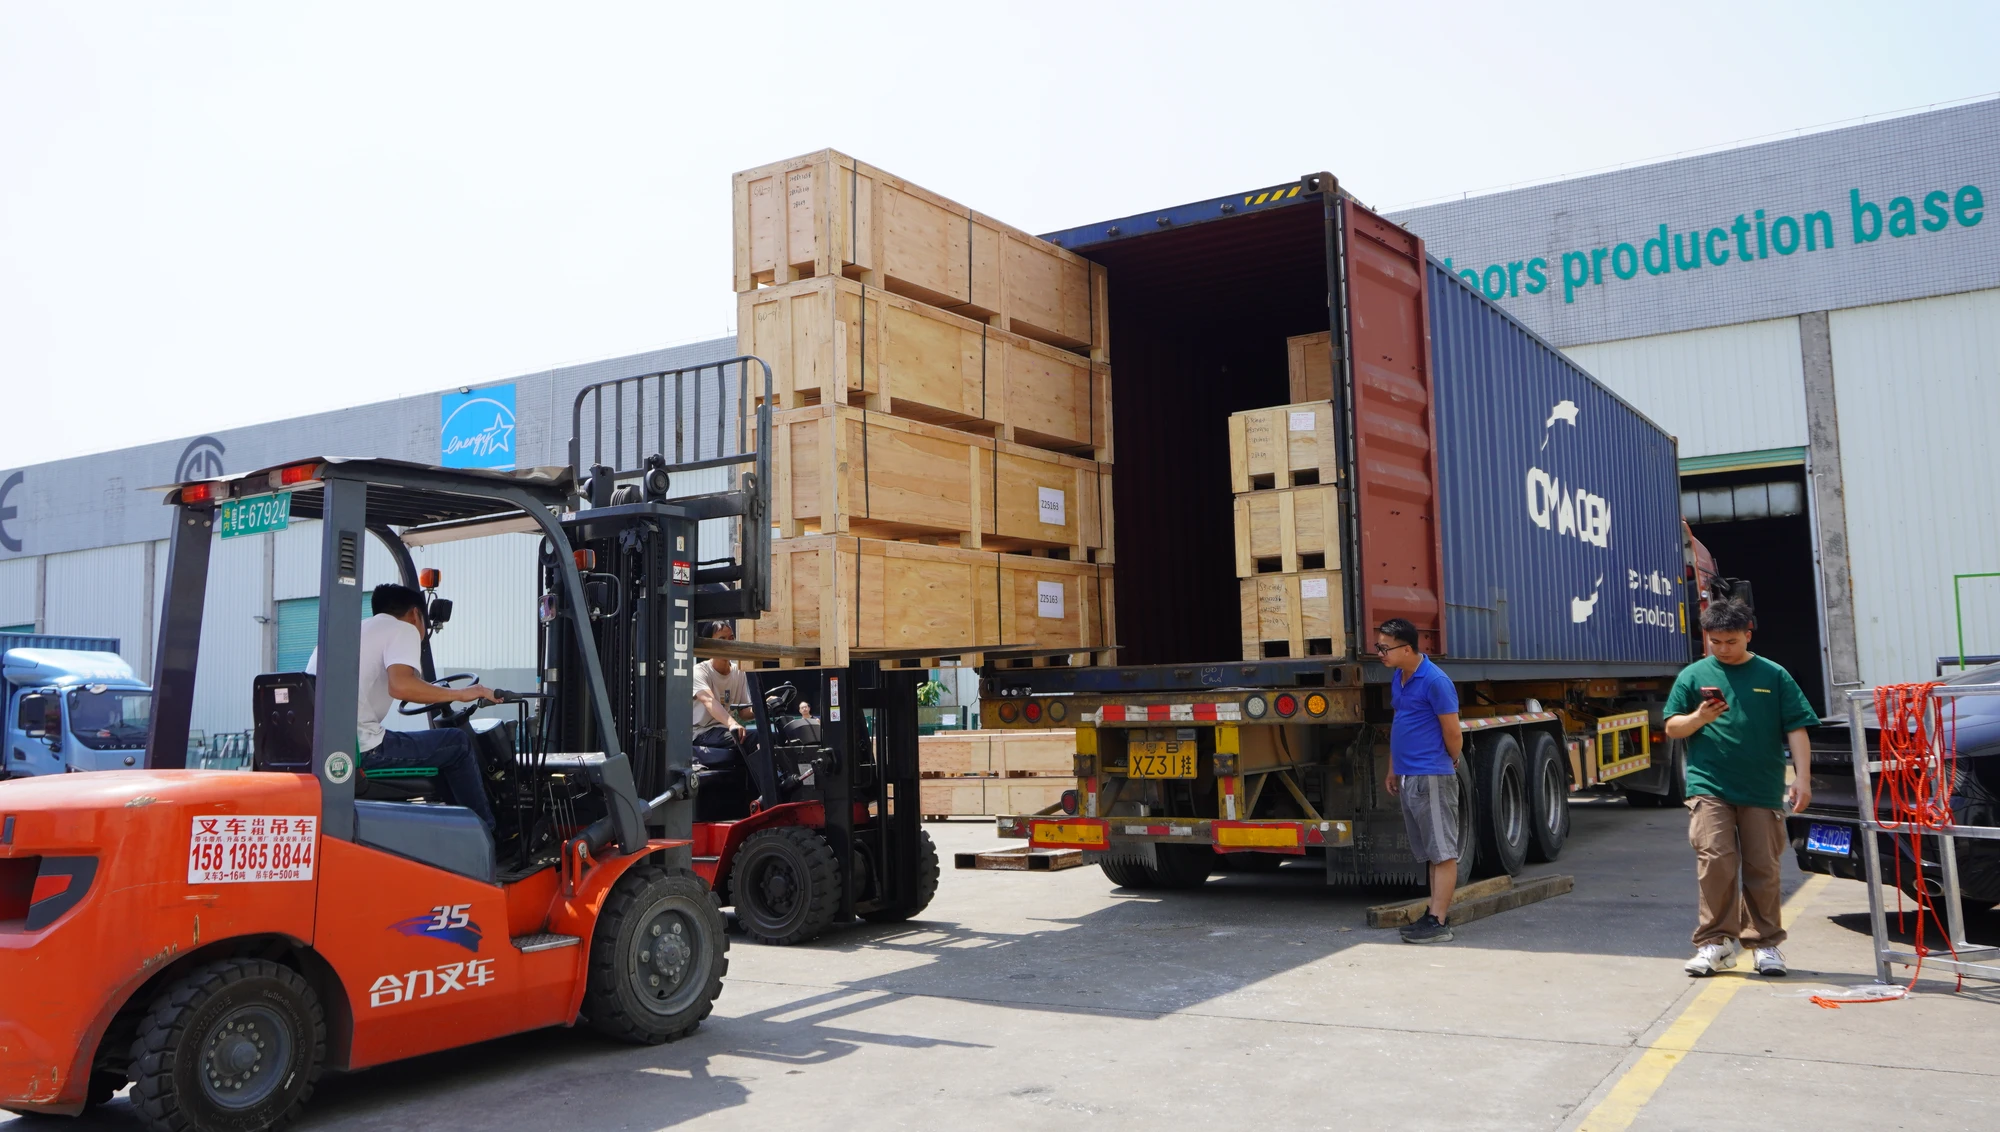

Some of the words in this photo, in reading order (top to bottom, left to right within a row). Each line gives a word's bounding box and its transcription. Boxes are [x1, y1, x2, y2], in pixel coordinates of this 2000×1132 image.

[1562, 209, 1834, 304] production
[1850, 184, 1984, 245] base
[442, 429, 493, 457] energy
[673, 599, 689, 677] HELI
[192, 843, 224, 871] 158
[229, 843, 268, 870] 1365
[272, 843, 312, 869] 8844
[426, 903, 472, 932] 35
[368, 958, 495, 1008] 合力叉车
